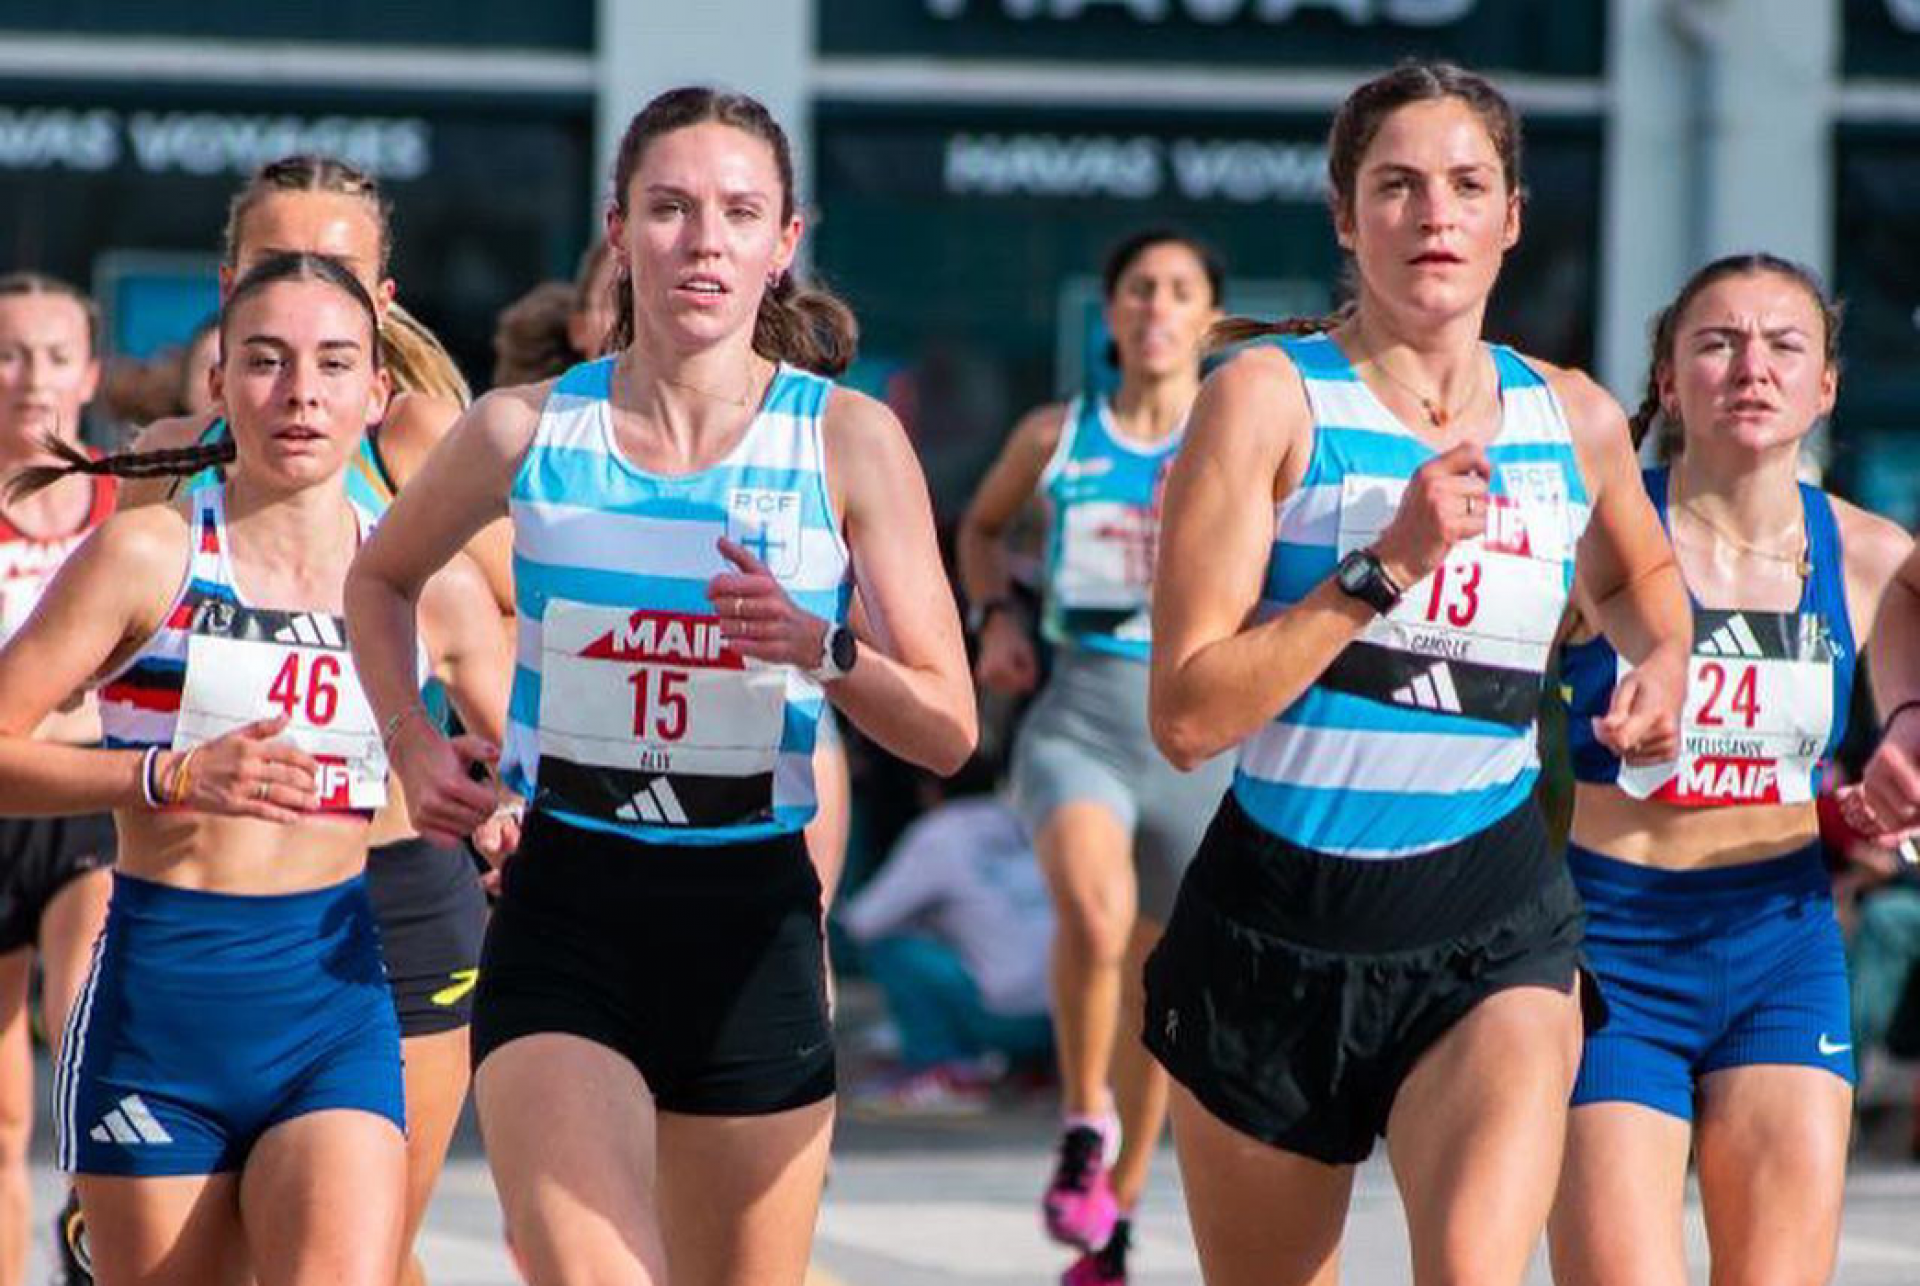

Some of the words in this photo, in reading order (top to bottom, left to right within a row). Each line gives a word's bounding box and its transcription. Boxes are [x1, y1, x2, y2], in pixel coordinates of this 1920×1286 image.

[735, 493, 797, 513] RCF
[1427, 561, 1481, 627] 13
[268, 652, 341, 726] 46
[628, 669, 689, 742] 15
[1696, 661, 1761, 728] 24
[315, 764, 348, 806] IF
[1677, 761, 1776, 799] MAIF
